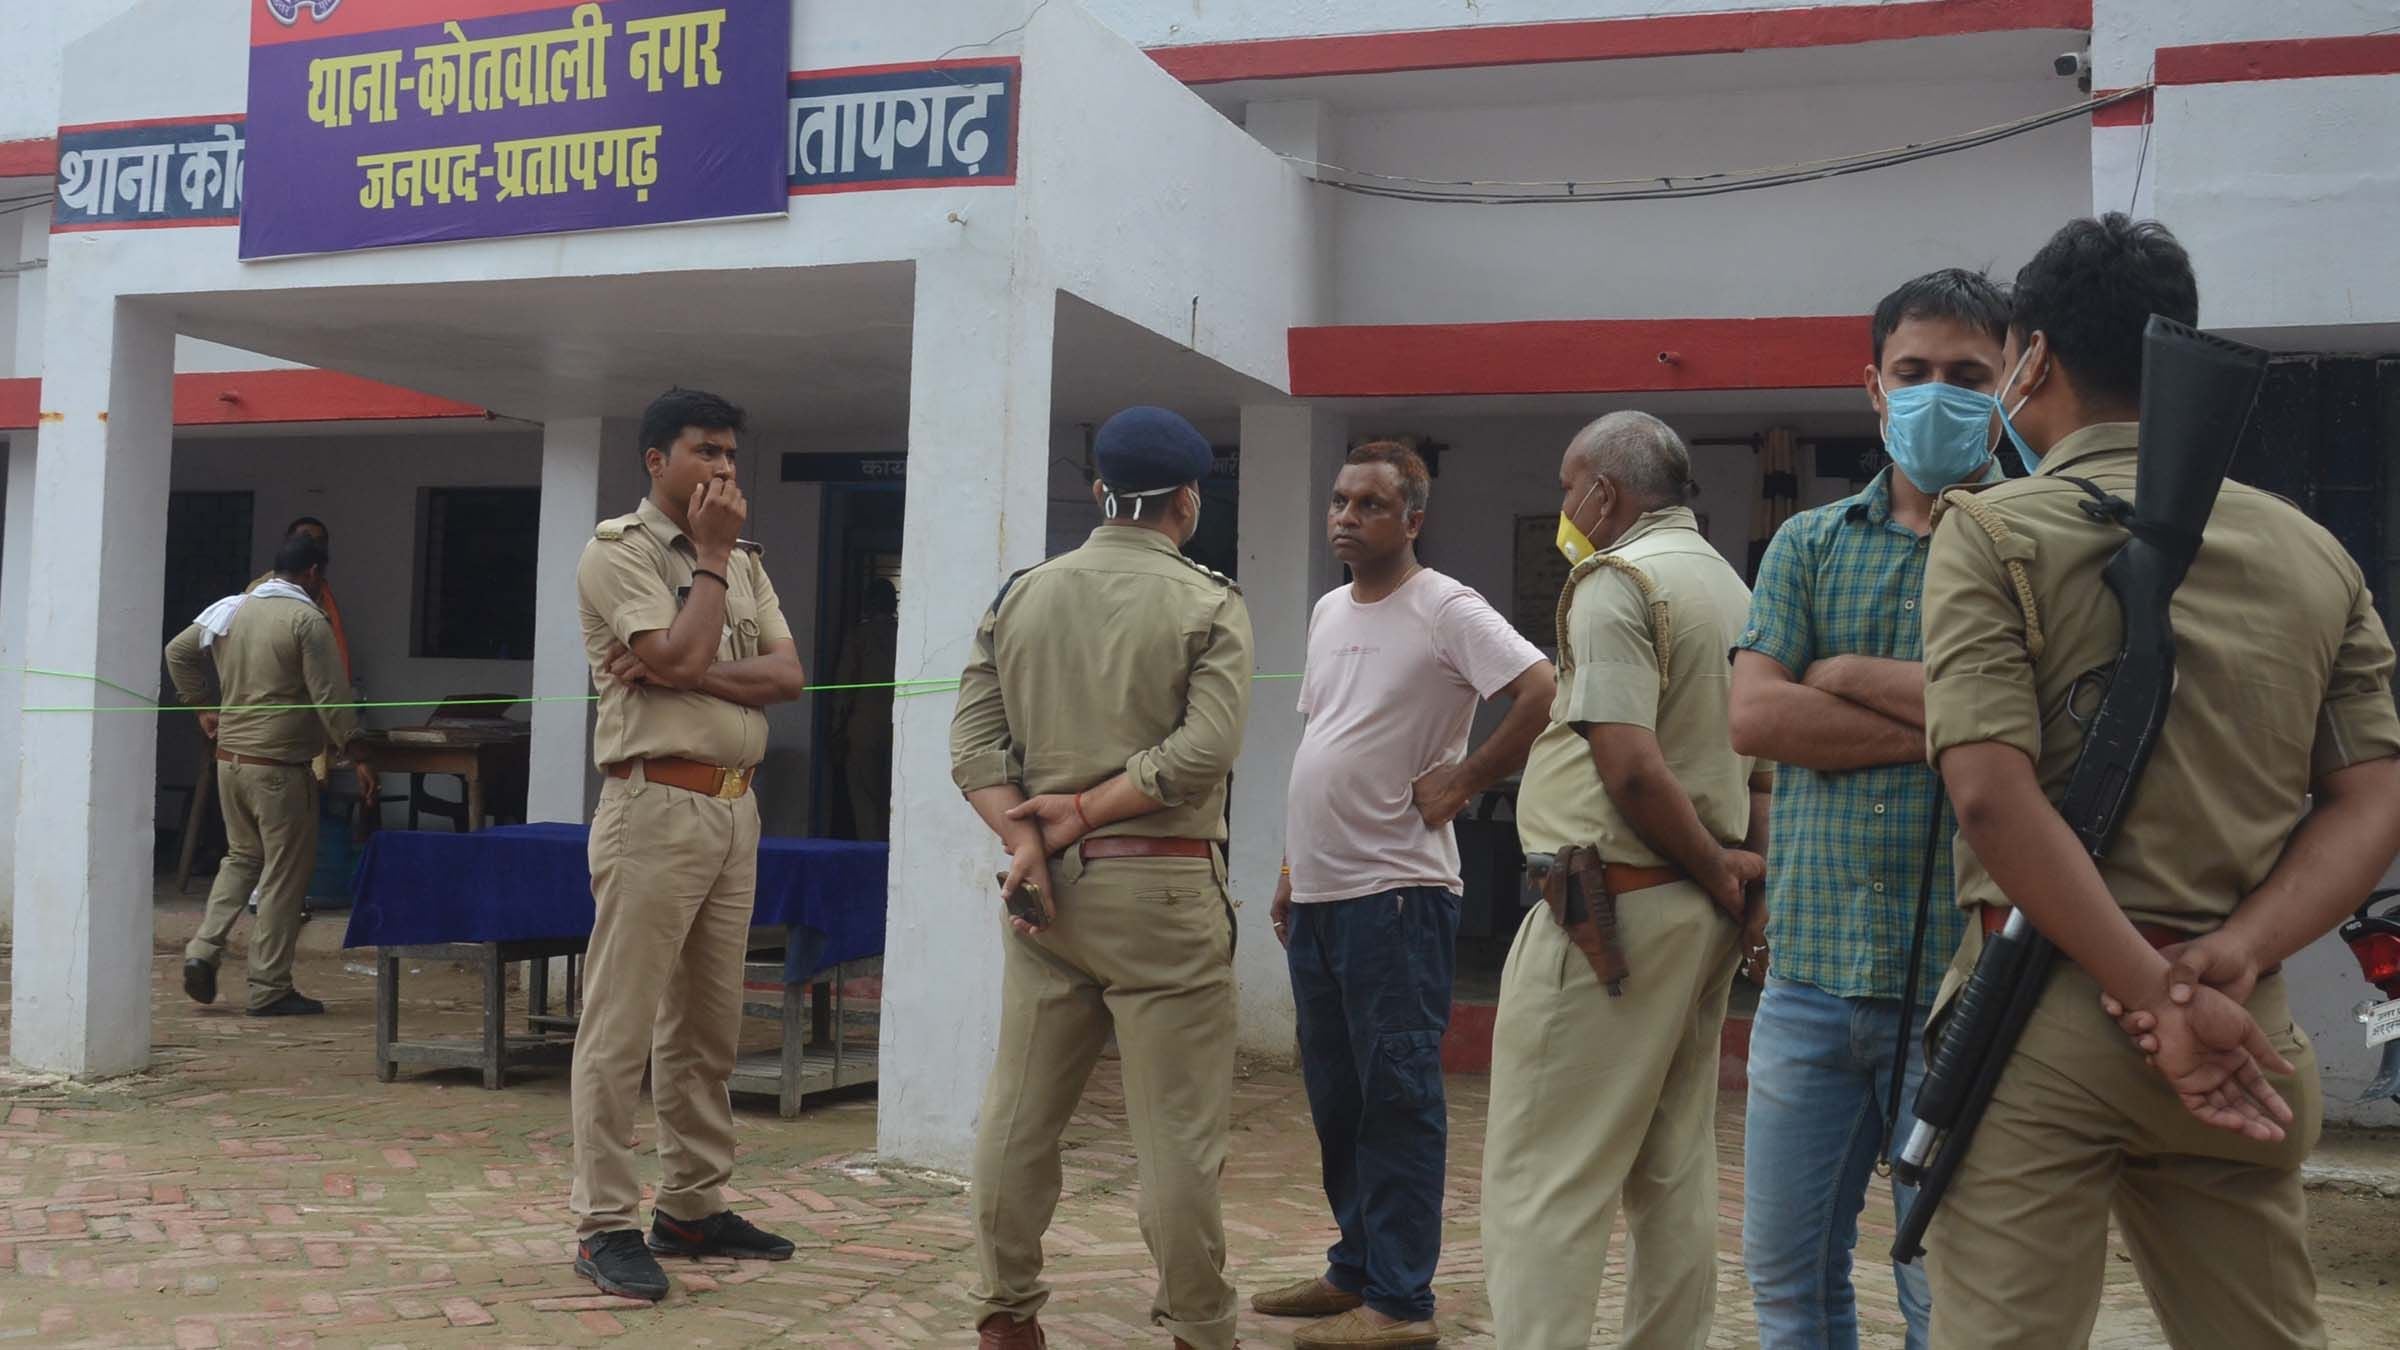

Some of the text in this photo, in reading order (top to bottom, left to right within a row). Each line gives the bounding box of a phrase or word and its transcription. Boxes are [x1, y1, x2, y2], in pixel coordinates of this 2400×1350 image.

[307, 3, 726, 128] थाना-कोतवाली नगर
[59, 144, 174, 215] थाना
